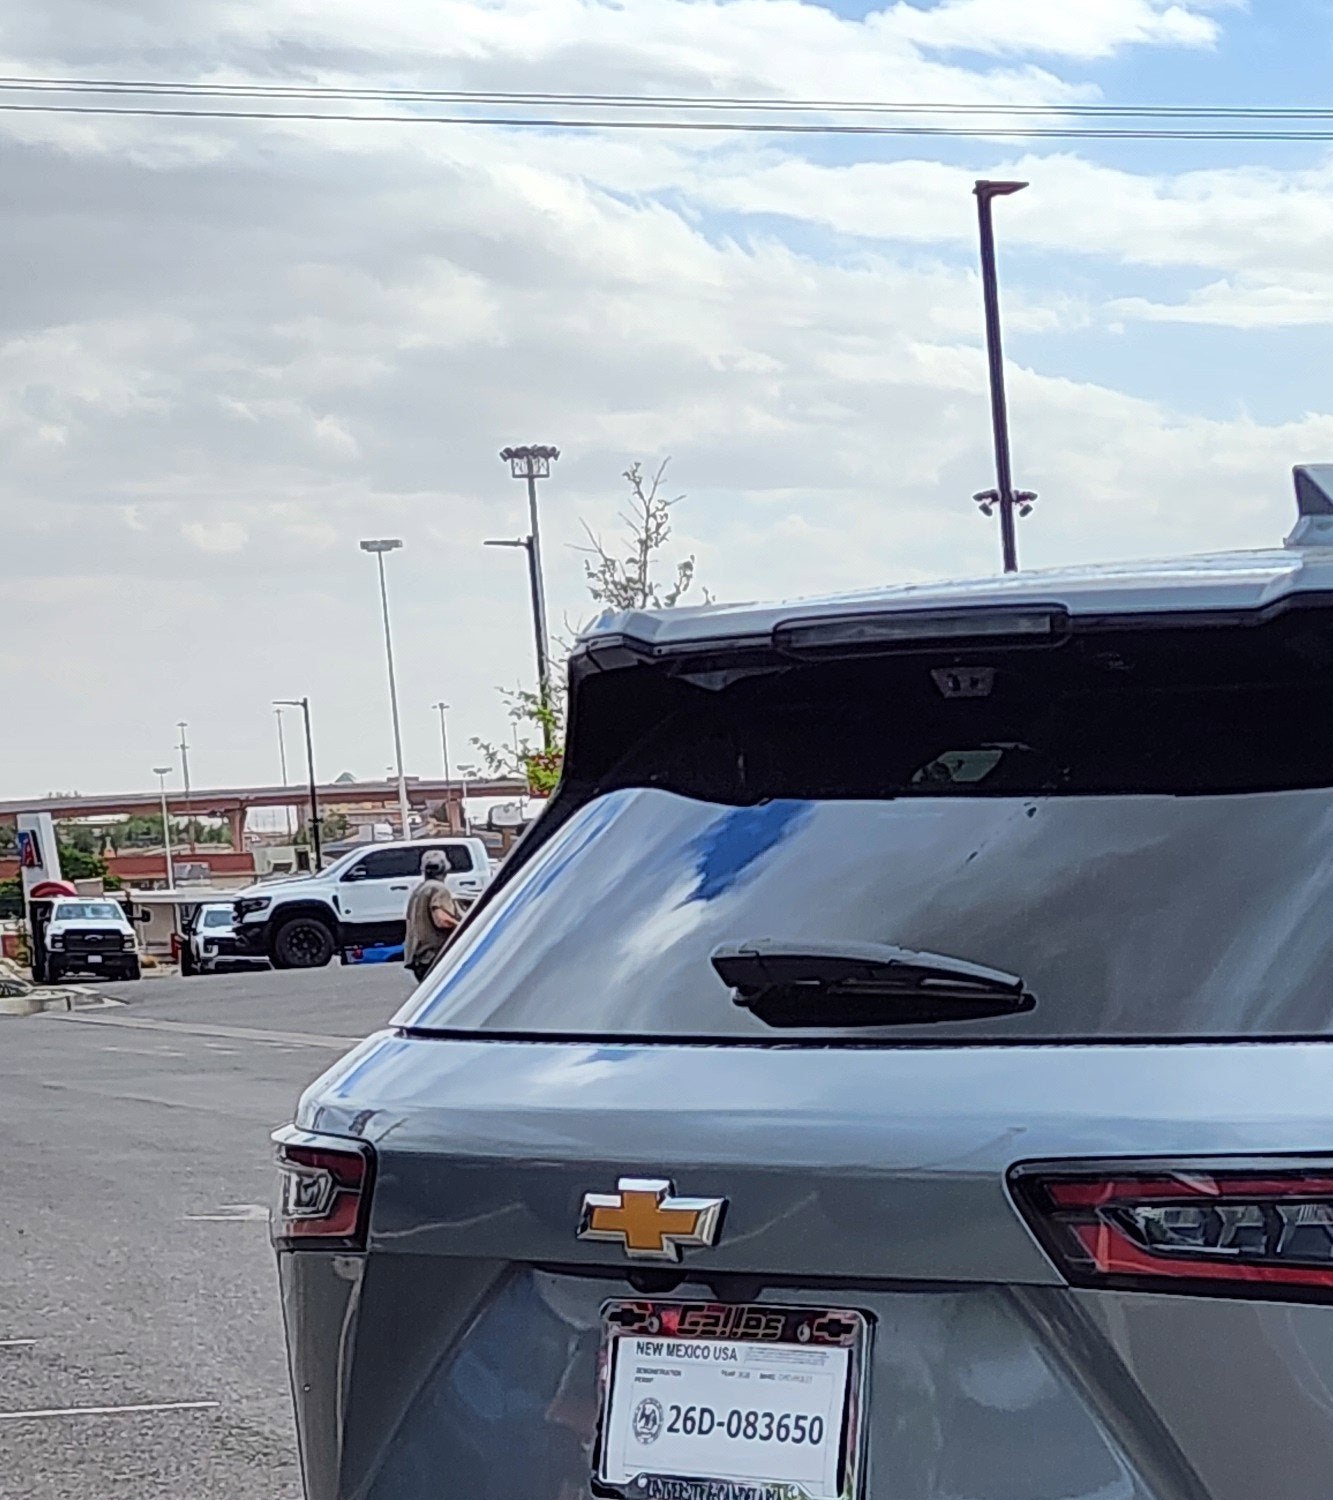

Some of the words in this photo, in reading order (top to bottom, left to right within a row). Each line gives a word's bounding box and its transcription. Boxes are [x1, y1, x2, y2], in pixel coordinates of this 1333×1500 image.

[636, 1341, 664, 1357] NEW
[666, 1342, 711, 1359] MEXICO
[713, 1346, 738, 1361] USA
[667, 1404, 824, 1446] 26D-083650
